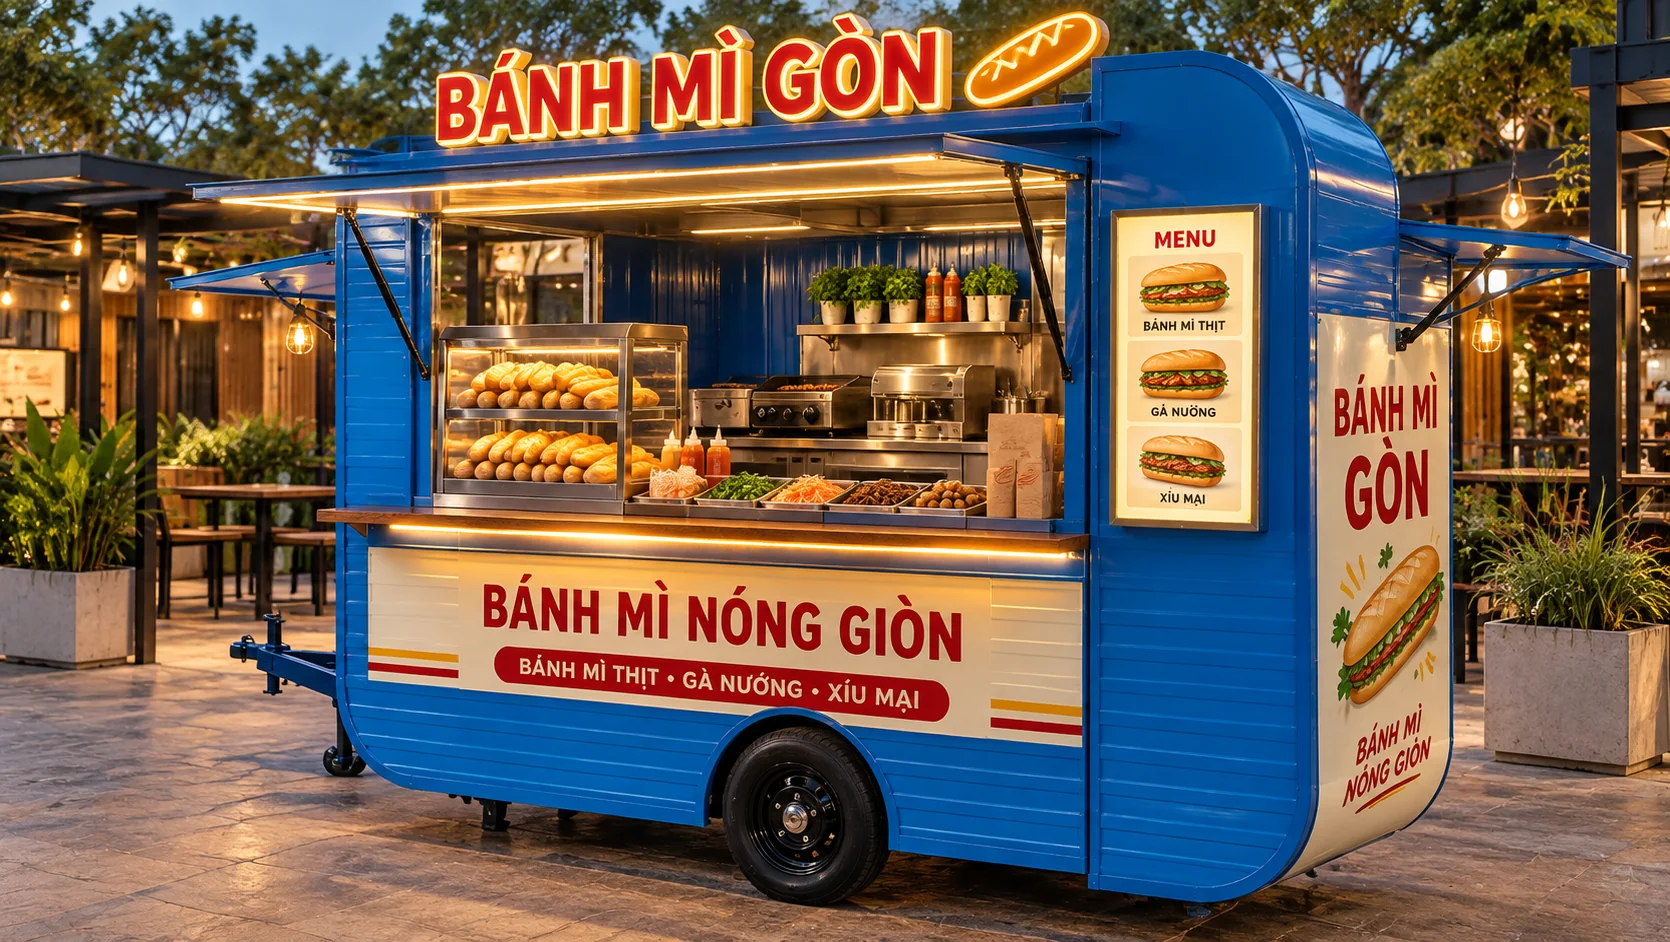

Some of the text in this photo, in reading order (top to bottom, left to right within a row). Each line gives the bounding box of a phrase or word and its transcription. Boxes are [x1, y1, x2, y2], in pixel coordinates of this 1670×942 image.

[436, 14, 945, 145] BÁNH MÌ GÒN
[1154, 229, 1216, 249] MENU
[1198, 320, 1226, 333] THỊT
[1334, 371, 1437, 437] BÁNH MÌ
[1183, 493, 1206, 507] MẠI
[1345, 435, 1429, 531] GÒN
[483, 573, 962, 662] BÁNH MÌ NÓNG GIÒN
[519, 654, 920, 714] BÁNH MÌ THỊT GÀ NƯỚNG XÍU MẠI
[1355, 719, 1400, 766] BÁNH
[1341, 757, 1391, 808] NÓNG
